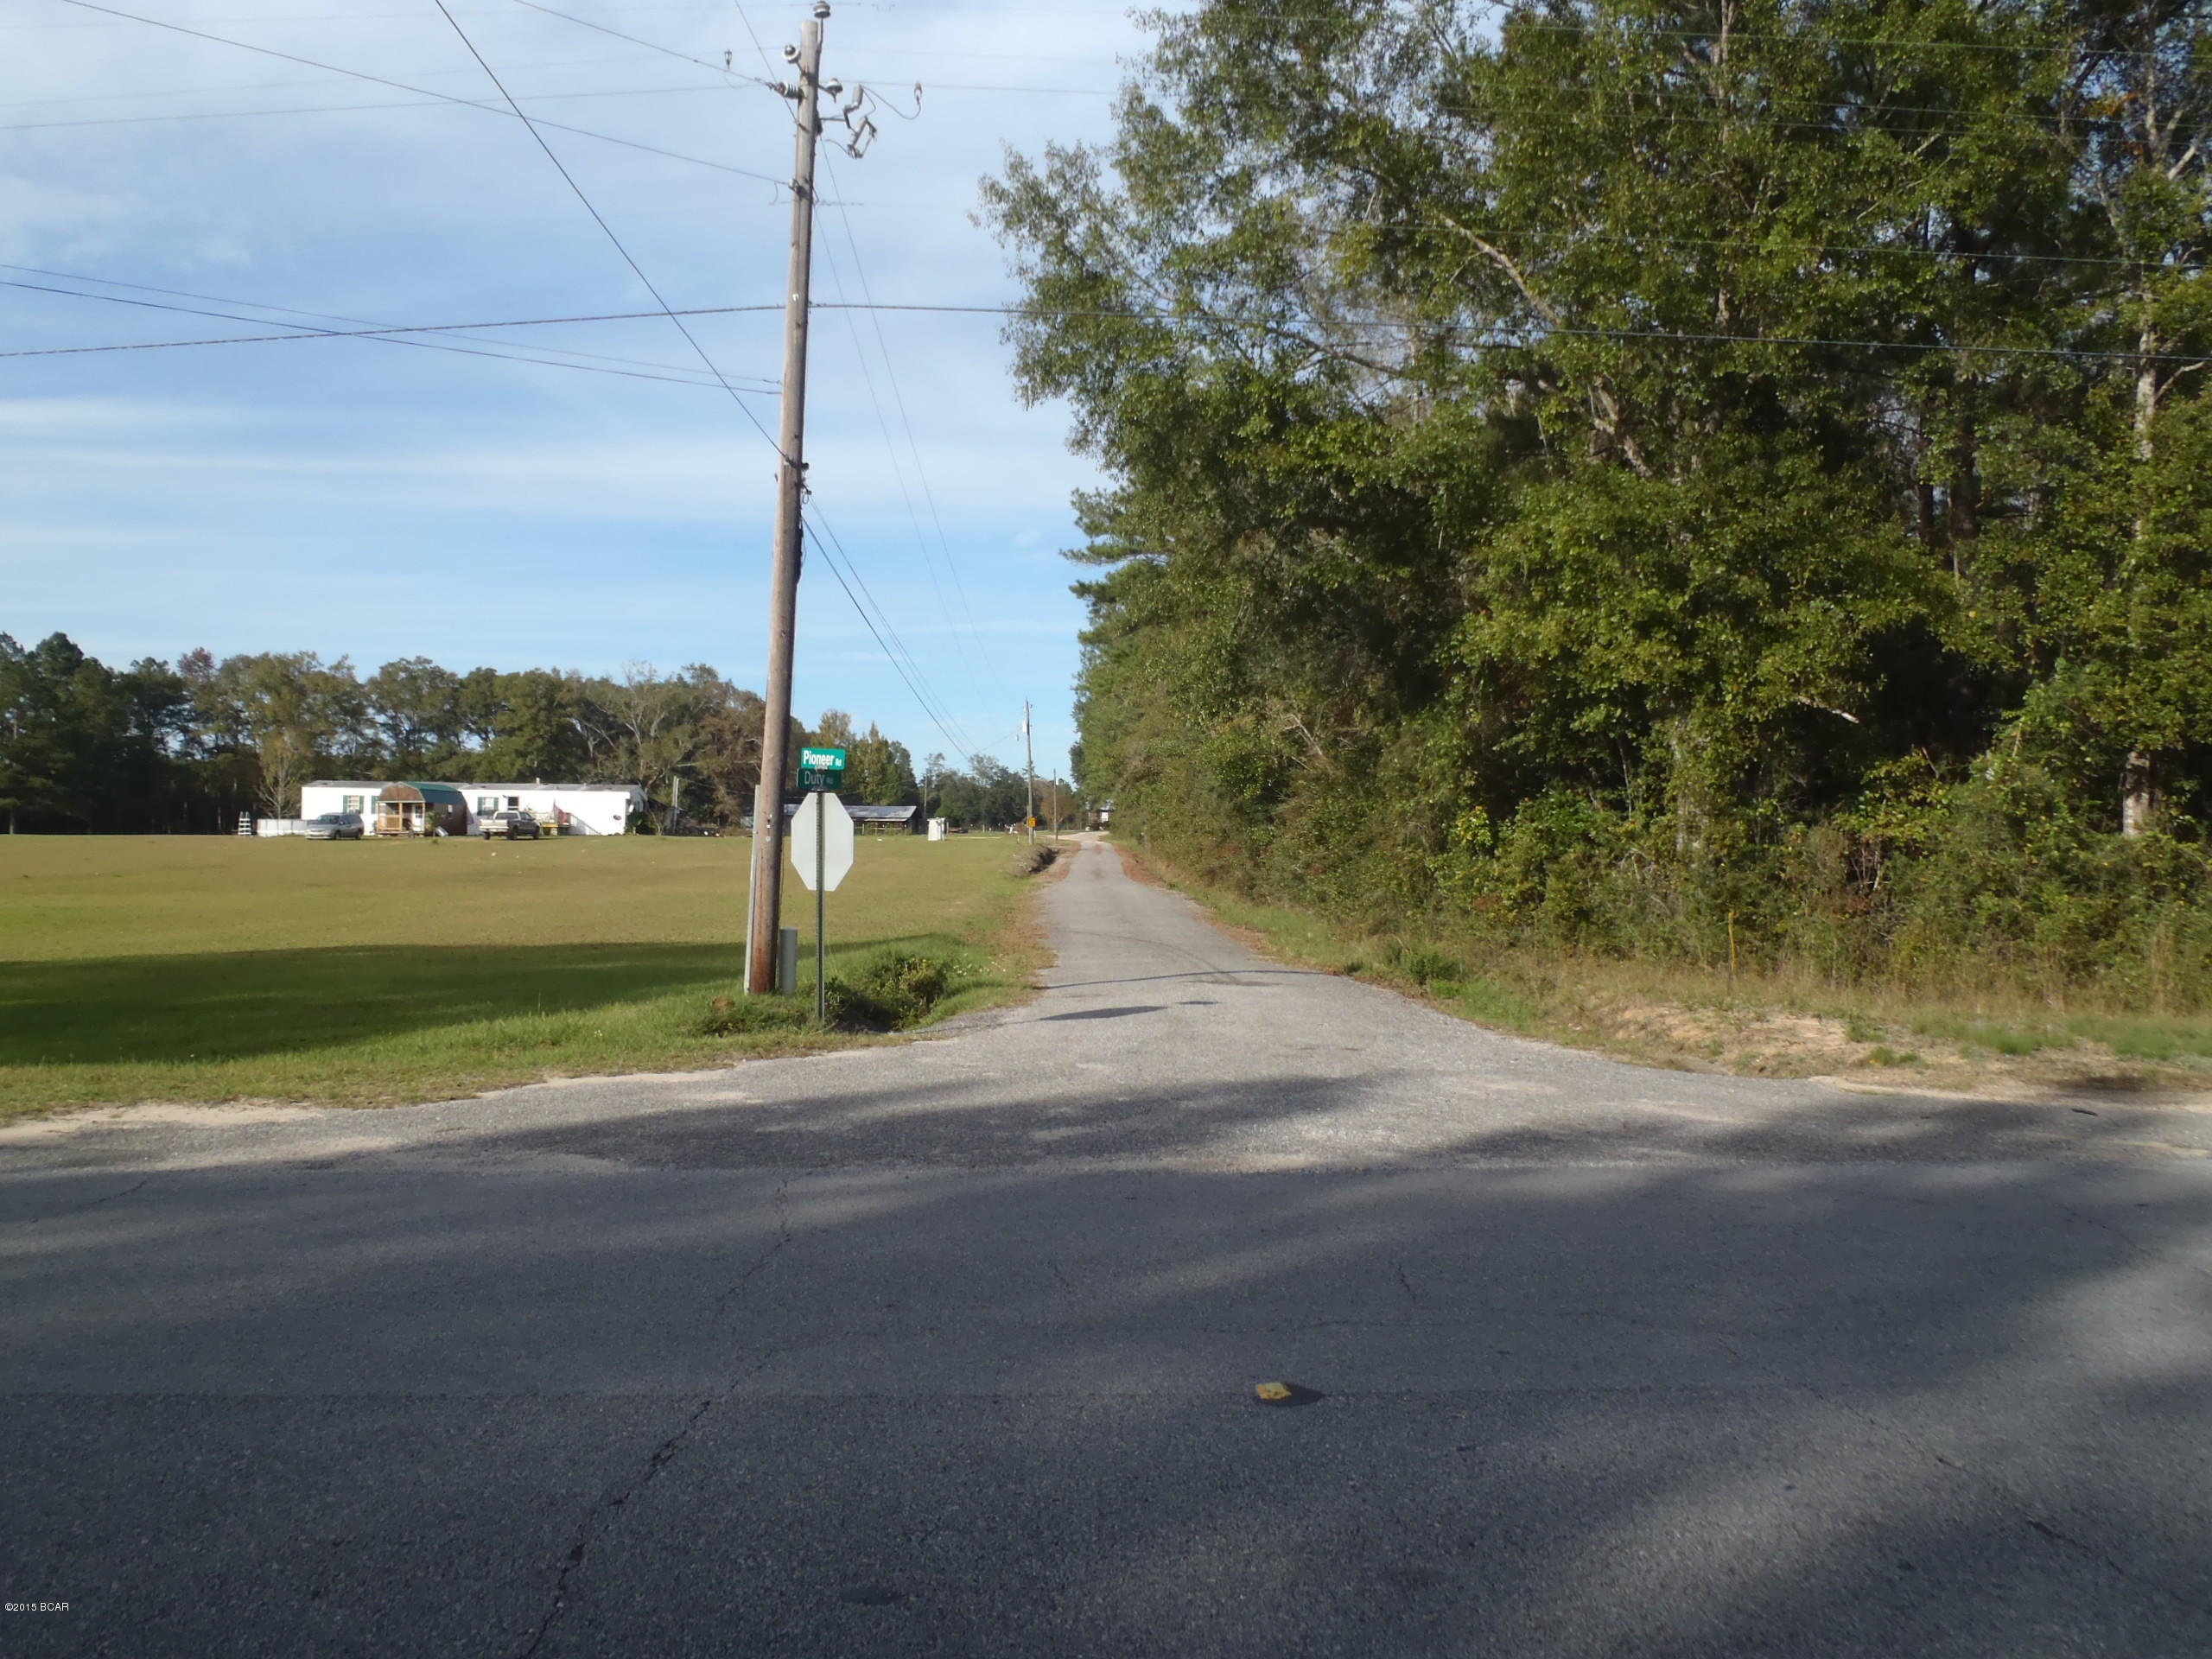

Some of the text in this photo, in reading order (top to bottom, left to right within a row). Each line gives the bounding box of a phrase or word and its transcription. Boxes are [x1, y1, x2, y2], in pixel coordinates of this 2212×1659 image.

[803, 750, 842, 766] Pioneer Rd
[804, 771, 824, 787] Duty
